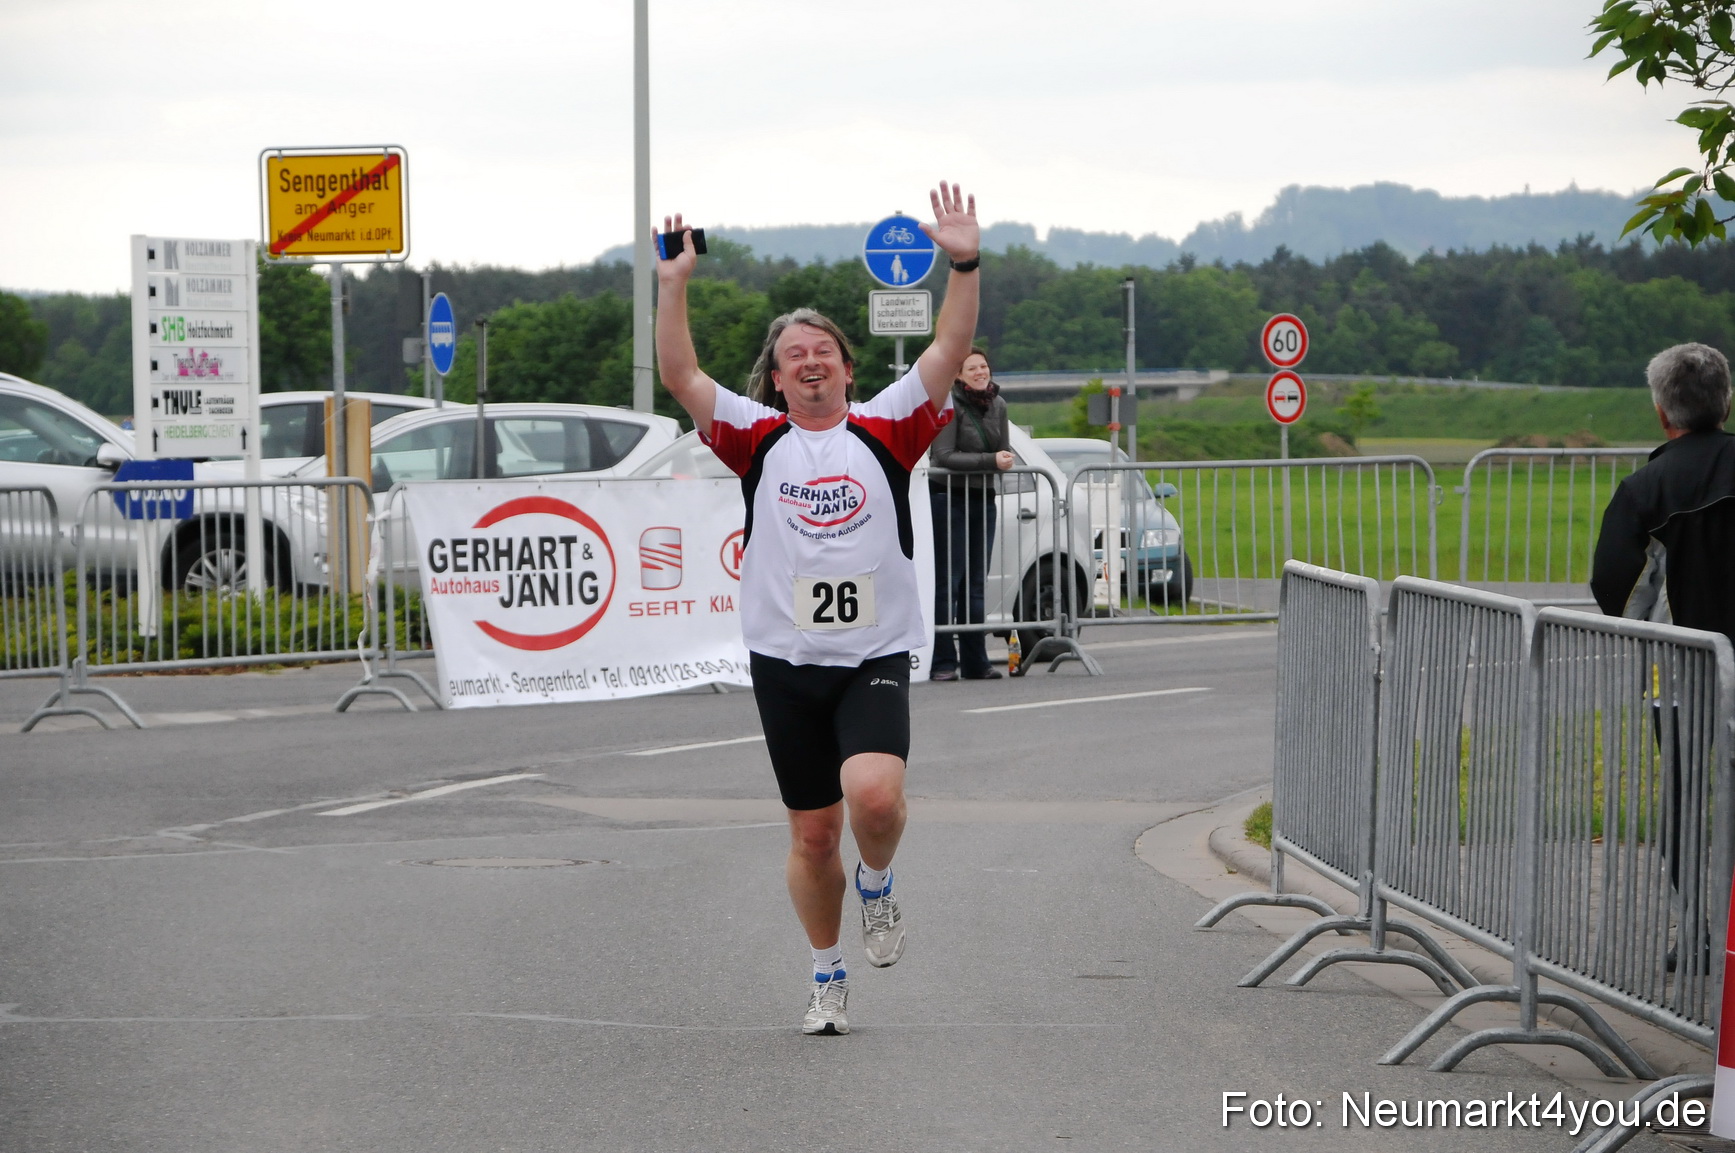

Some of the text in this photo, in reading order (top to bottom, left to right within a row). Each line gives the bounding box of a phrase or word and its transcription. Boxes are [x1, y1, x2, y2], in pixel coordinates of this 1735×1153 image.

[279, 167, 389, 198] Sengenthal
[294, 200, 375, 218] am Anger
[307, 229, 356, 242] Neumarkt
[880, 297, 920, 306] Landwirt-
[877, 309, 925, 318] schaftlicher
[877, 319, 925, 329] Verkehr frei
[1273, 330, 1297, 353] 60
[162, 389, 202, 415] THULE
[164, 424, 235, 439] HEIDELBERGCEMENT
[778, 495, 812, 509] Autohaus
[779, 482, 849, 502] GERHART
[786, 513, 872, 540] Das sportliche Autohaus
[428, 535, 594, 574] GERHART &
[430, 570, 599, 608] Autohaus JÄNIG
[629, 595, 734, 617] SEAT KIA
[812, 580, 859, 624] 26
[510, 668, 591, 698] Sengenthal
[600, 666, 628, 689] Tel.
[629, 662, 698, 687] 09181/26
[880, 678, 899, 687] asics
